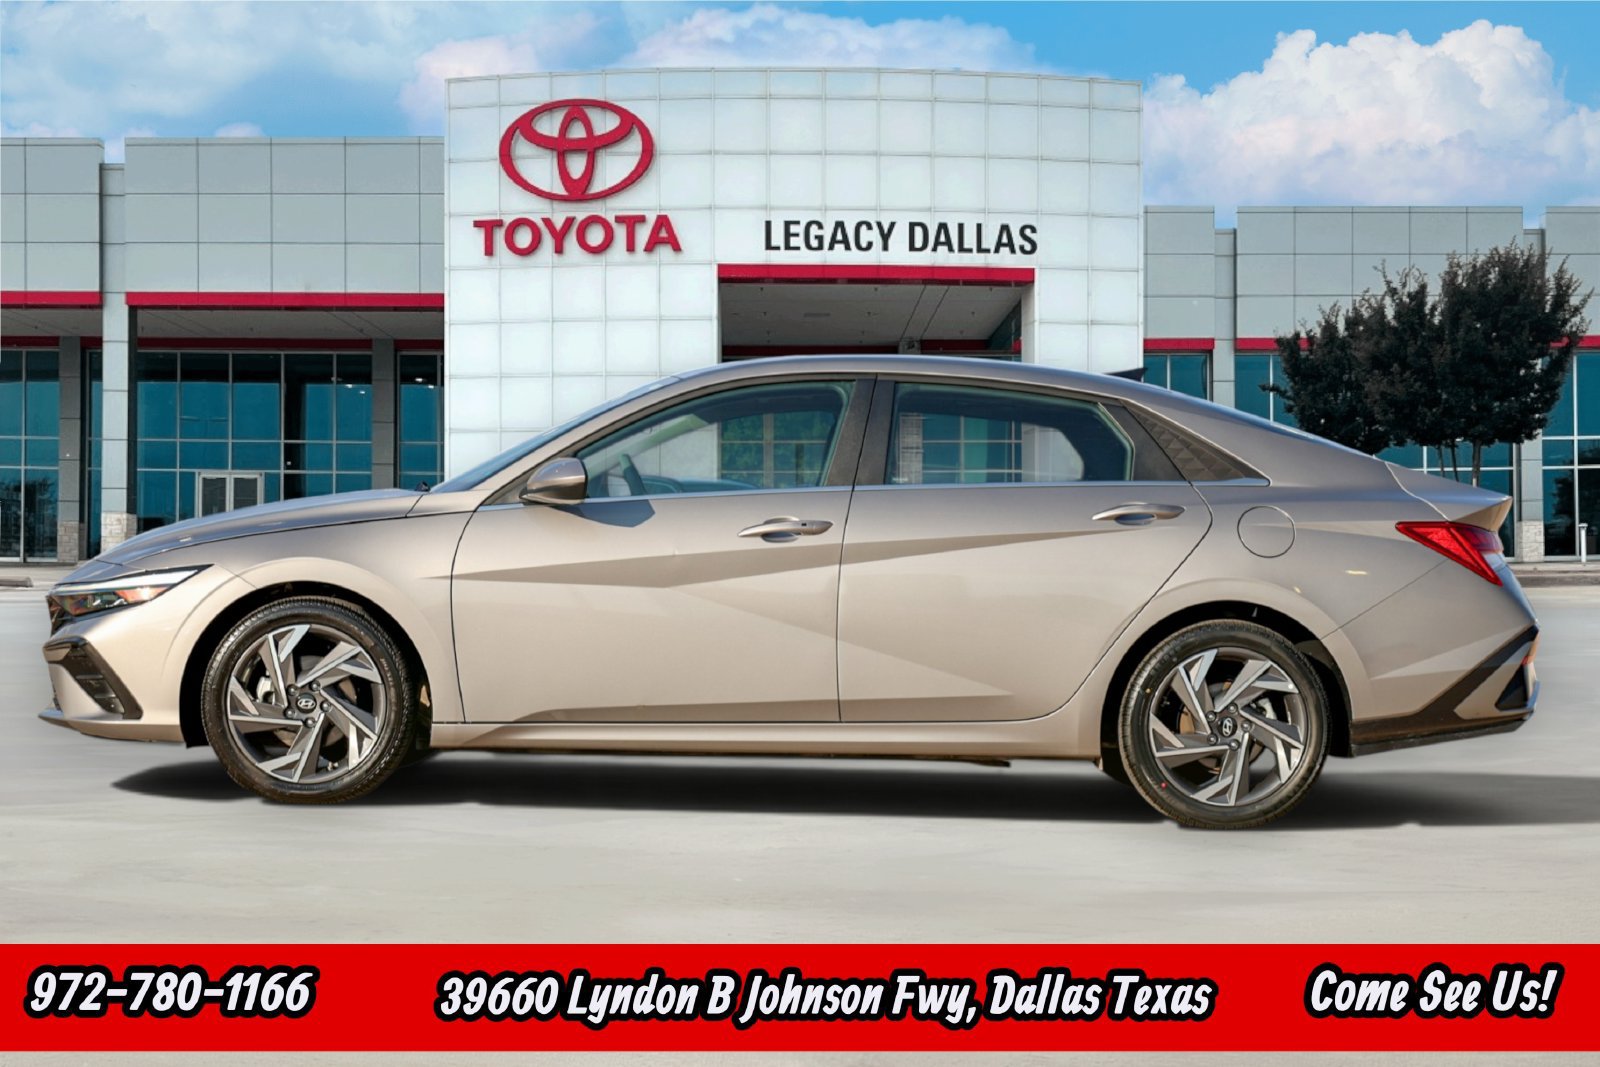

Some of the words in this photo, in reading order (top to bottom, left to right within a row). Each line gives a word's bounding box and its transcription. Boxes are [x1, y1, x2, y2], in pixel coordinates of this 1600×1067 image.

[473, 213, 682, 257] TOYOTA
[764, 219, 897, 252] LEGACY
[908, 221, 1038, 256] DALLAS
